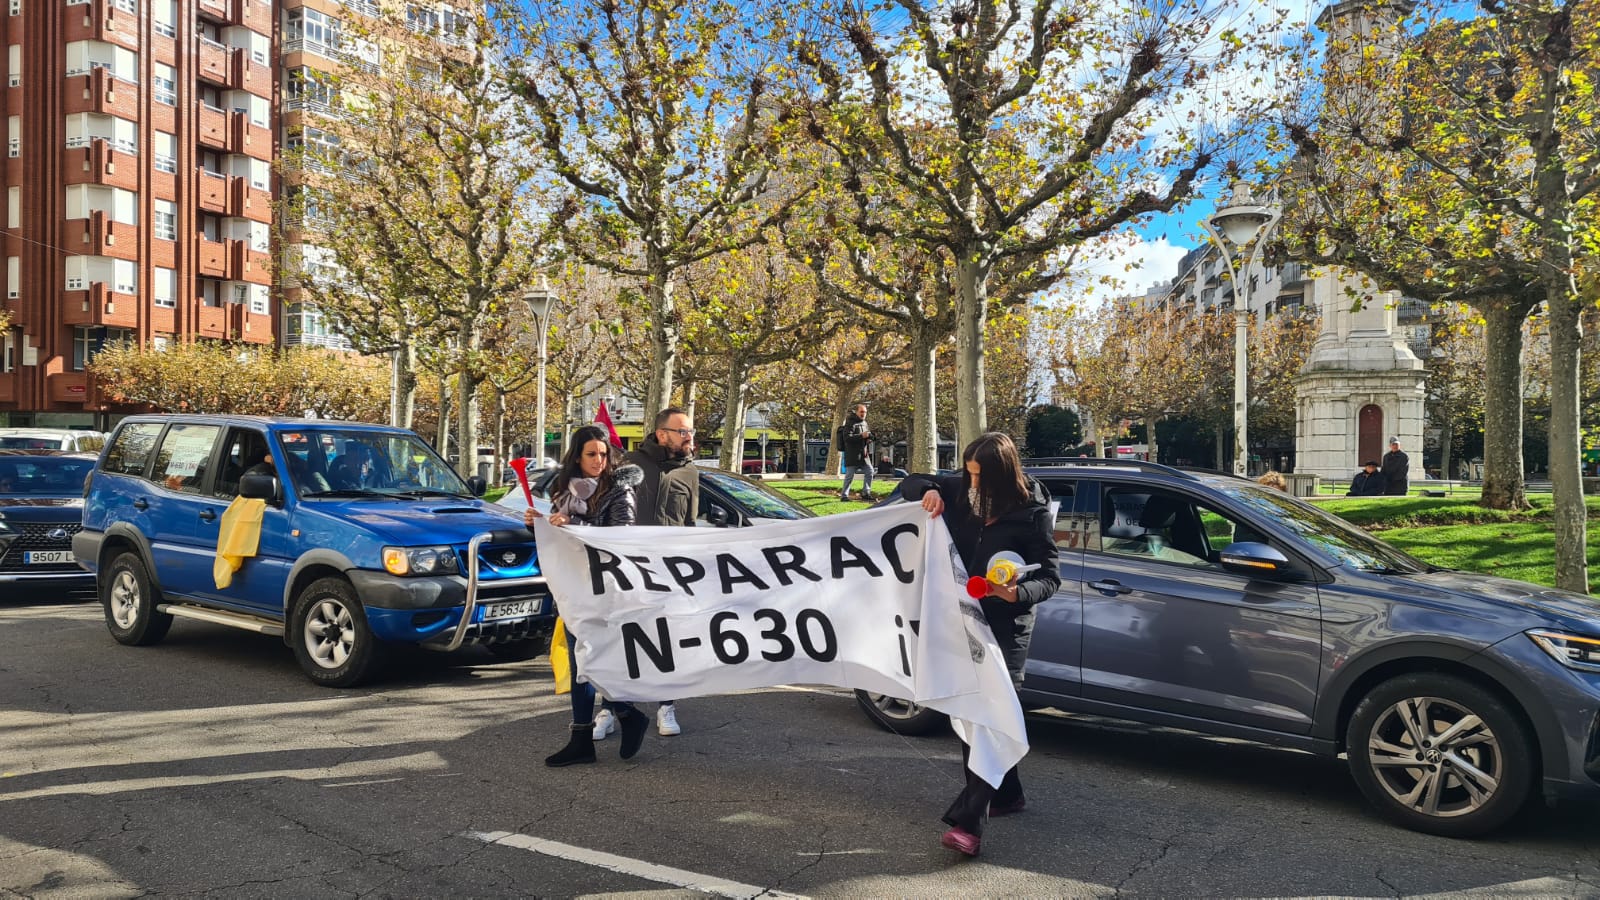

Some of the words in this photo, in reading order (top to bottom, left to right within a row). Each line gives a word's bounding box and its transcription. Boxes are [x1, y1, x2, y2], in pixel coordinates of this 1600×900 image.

[32, 552, 62, 562] 9507
[584, 523, 919, 596] REPARAC
[485, 604, 499, 618] LE
[500, 602, 525, 616] 5634
[621, 607, 838, 679] N-630
